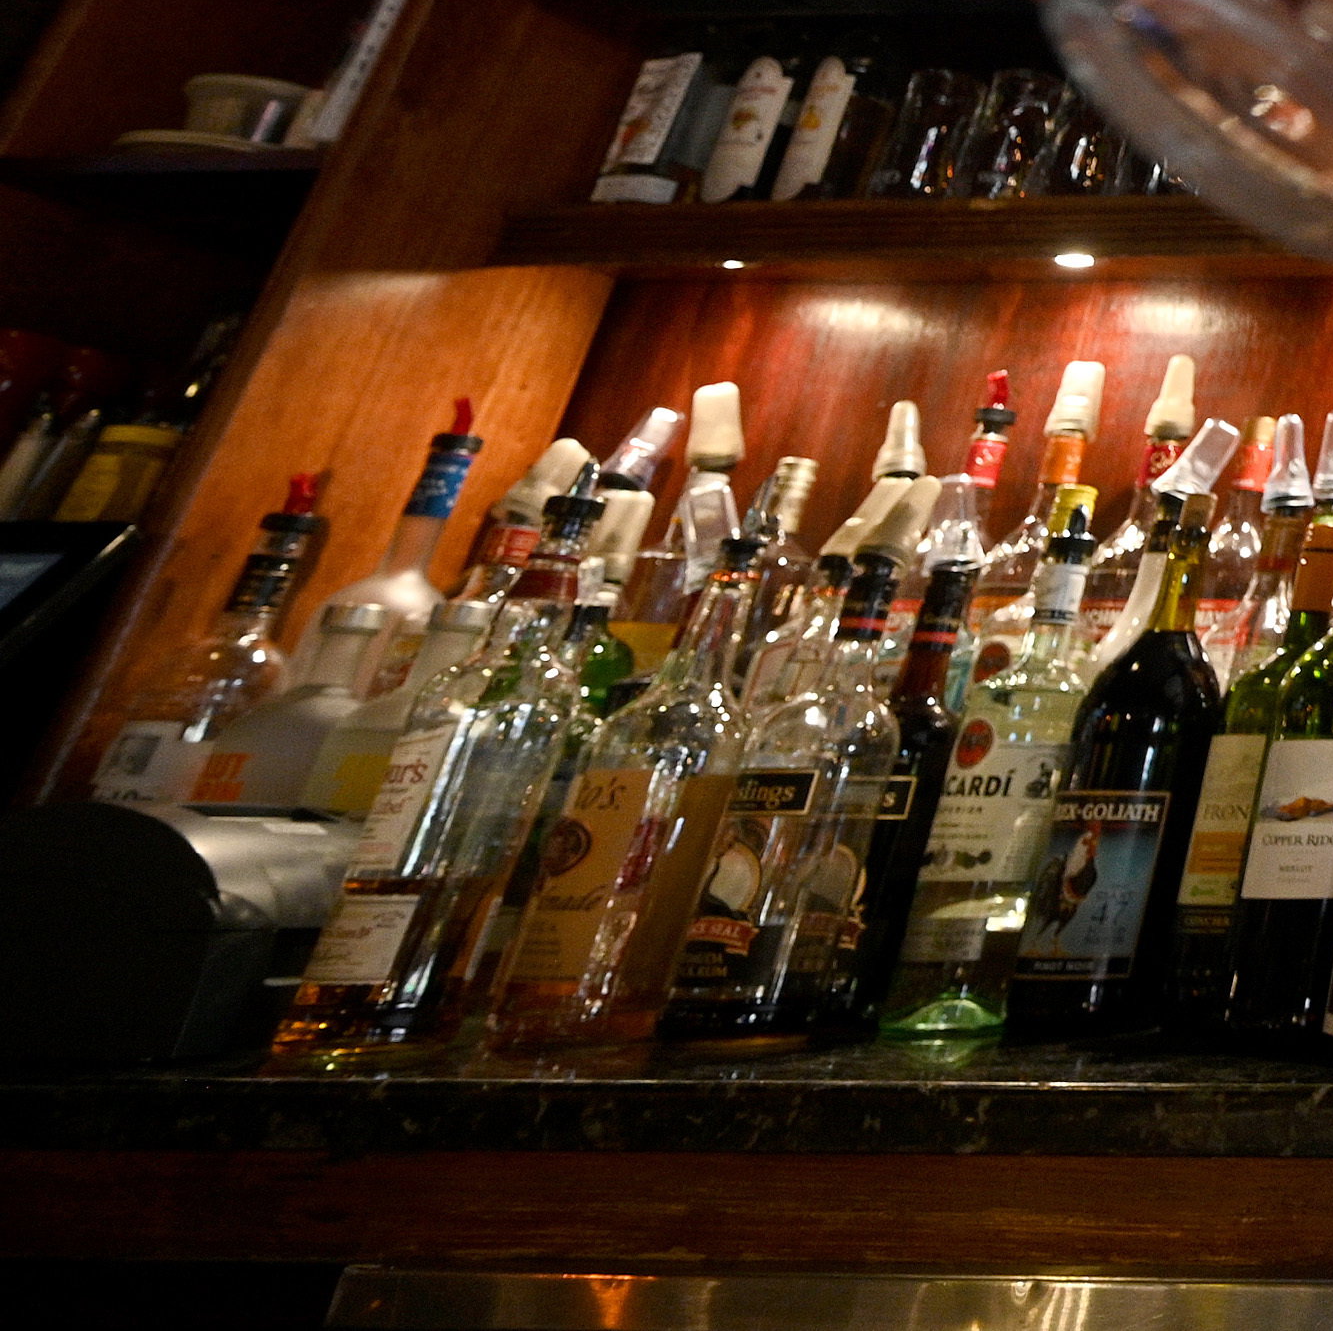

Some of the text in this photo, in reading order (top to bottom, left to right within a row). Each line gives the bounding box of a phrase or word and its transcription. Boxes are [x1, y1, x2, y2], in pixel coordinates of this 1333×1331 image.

[945, 770, 1016, 797] CARDÍ
[1056, 802, 1162, 822] EX-GOLIATH
[1204, 804, 1250, 820] FRON
[1262, 834, 1303, 847] COPPER
